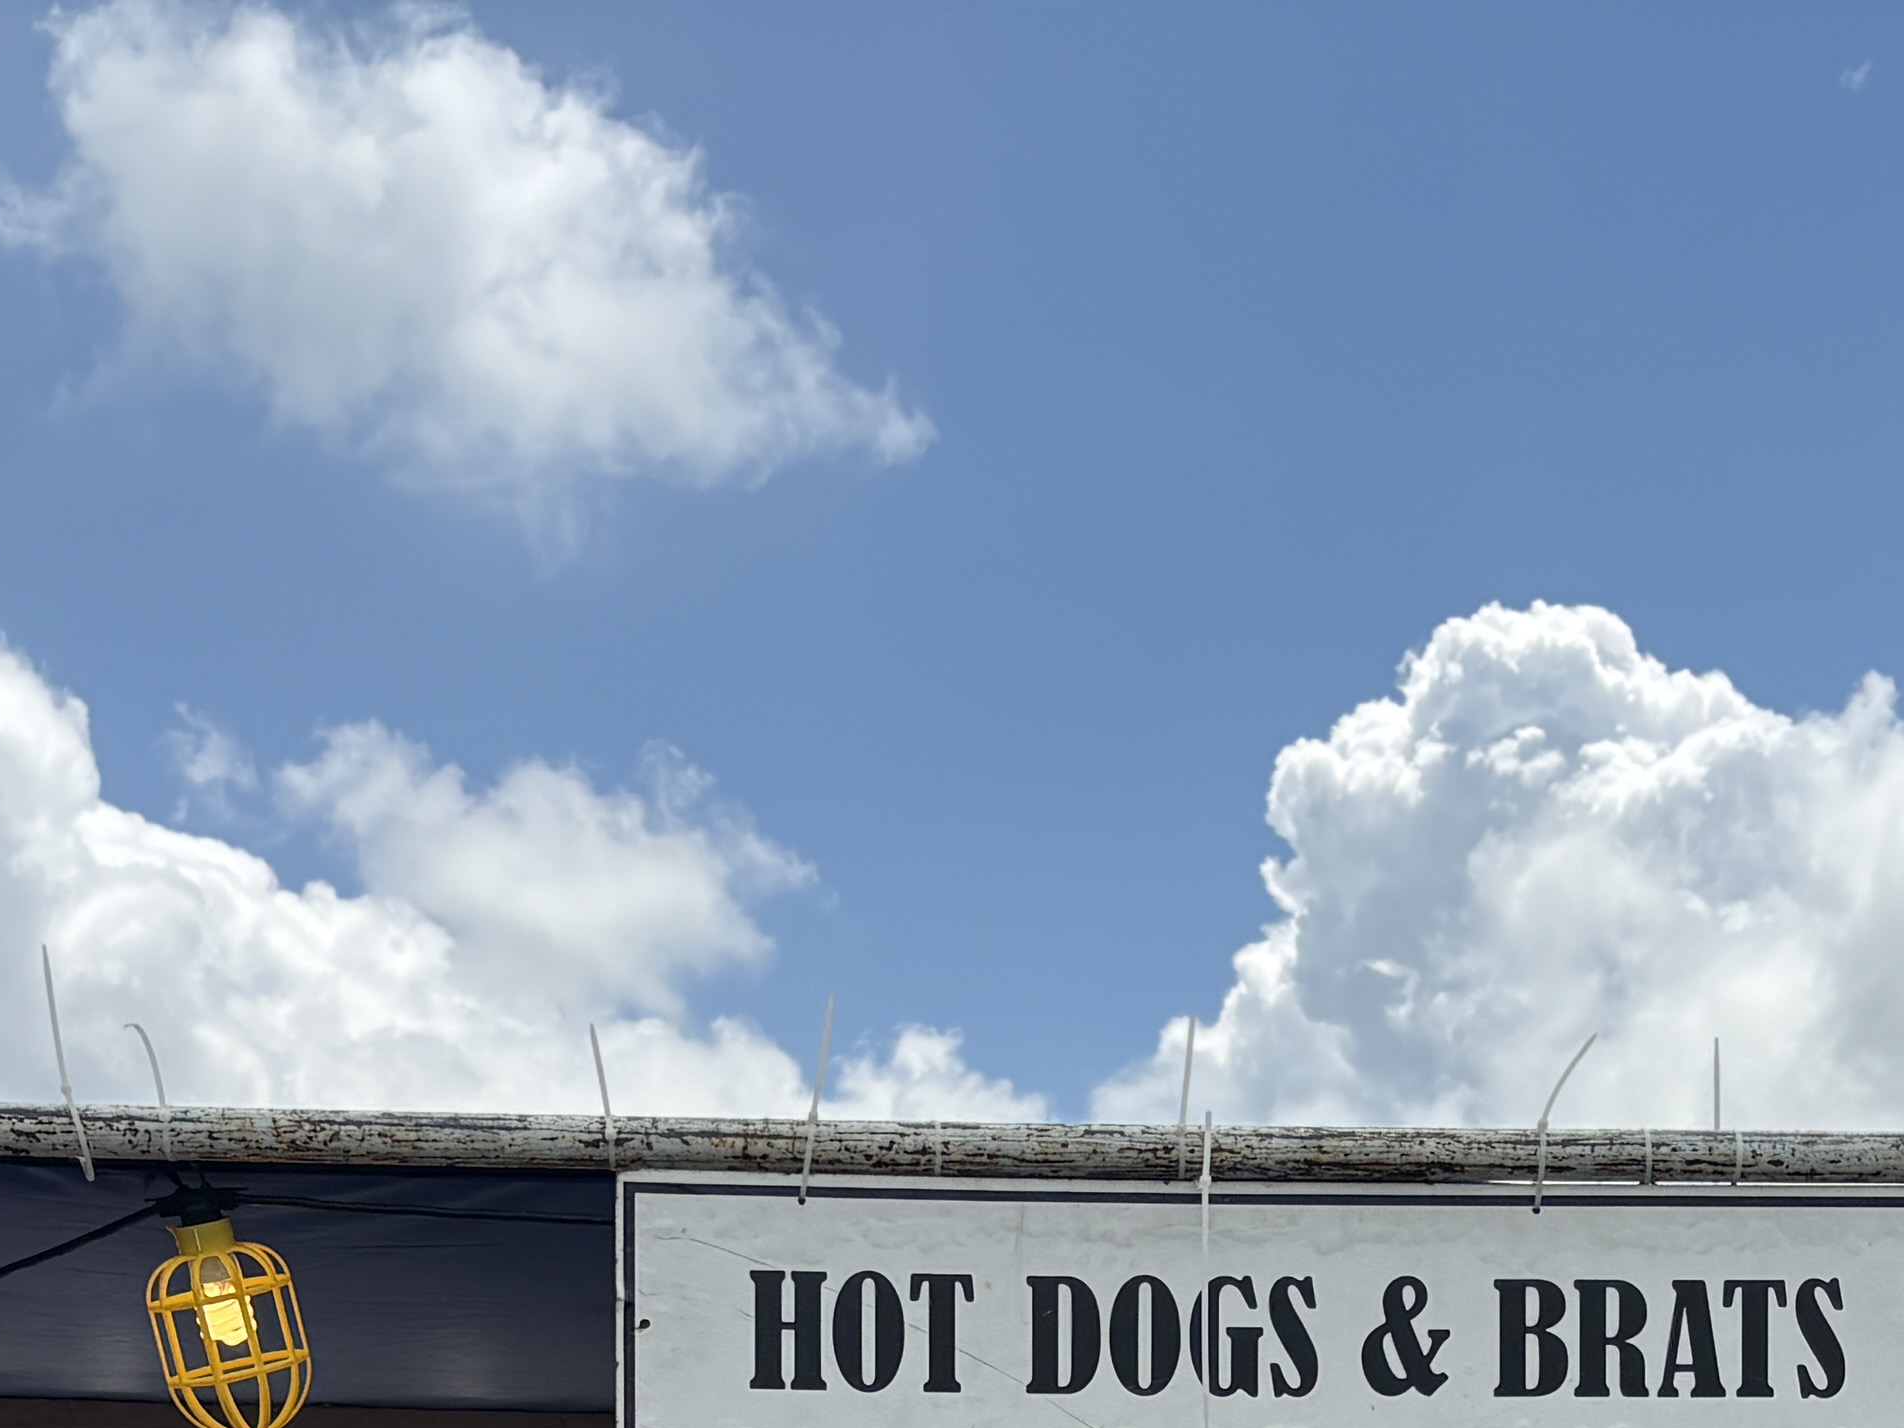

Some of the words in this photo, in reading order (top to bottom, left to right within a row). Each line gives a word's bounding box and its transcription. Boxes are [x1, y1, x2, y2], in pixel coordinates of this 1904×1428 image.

[749, 1269, 975, 1395] HOT
[1026, 1273, 1319, 1399] DOGS
[1360, 1275, 1451, 1397] &
[1494, 1276, 1846, 1400] BRATS
